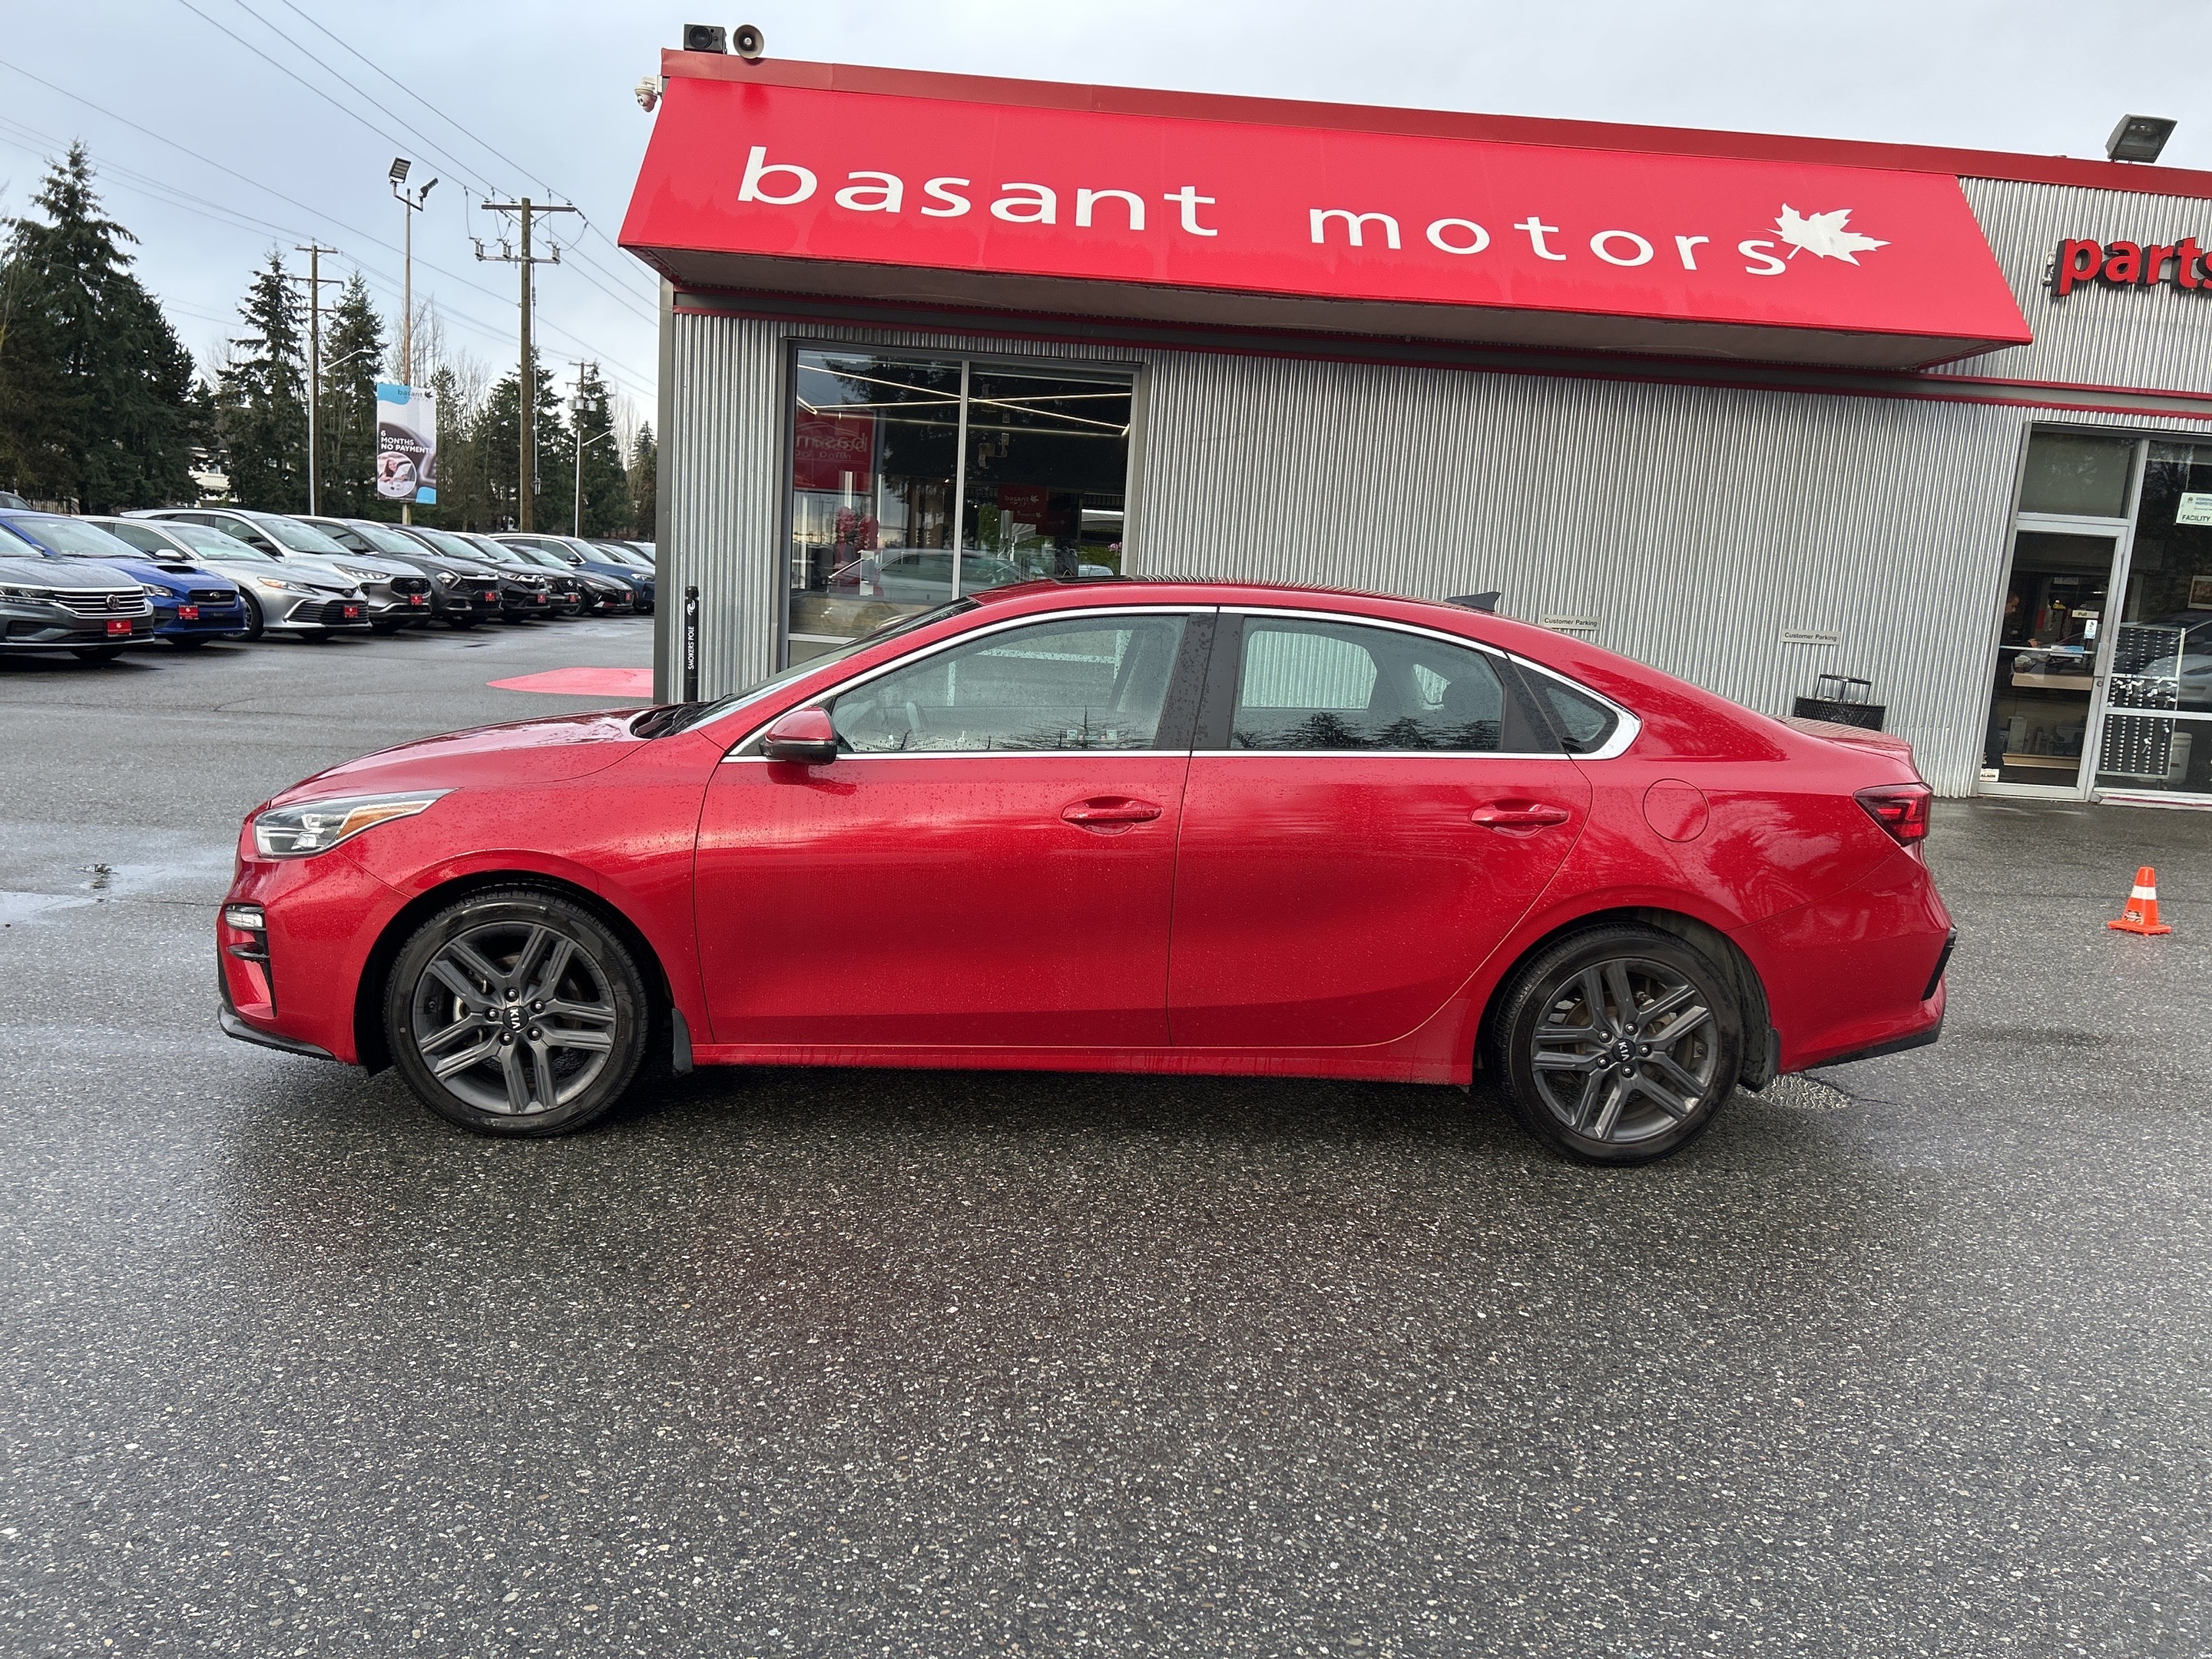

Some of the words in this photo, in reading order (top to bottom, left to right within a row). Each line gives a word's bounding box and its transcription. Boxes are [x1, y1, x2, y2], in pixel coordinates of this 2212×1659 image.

[737, 146, 1218, 237] basant
[1309, 207, 1787, 276] motors
[397, 389, 422, 397] basant
[380, 437, 415, 445] MONTHS
[1575, 619, 1598, 628] Parking
[1815, 634, 1837, 642] Parking
[509, 1008, 521, 1029] KIA
[1618, 1041, 1630, 1061] KIA
